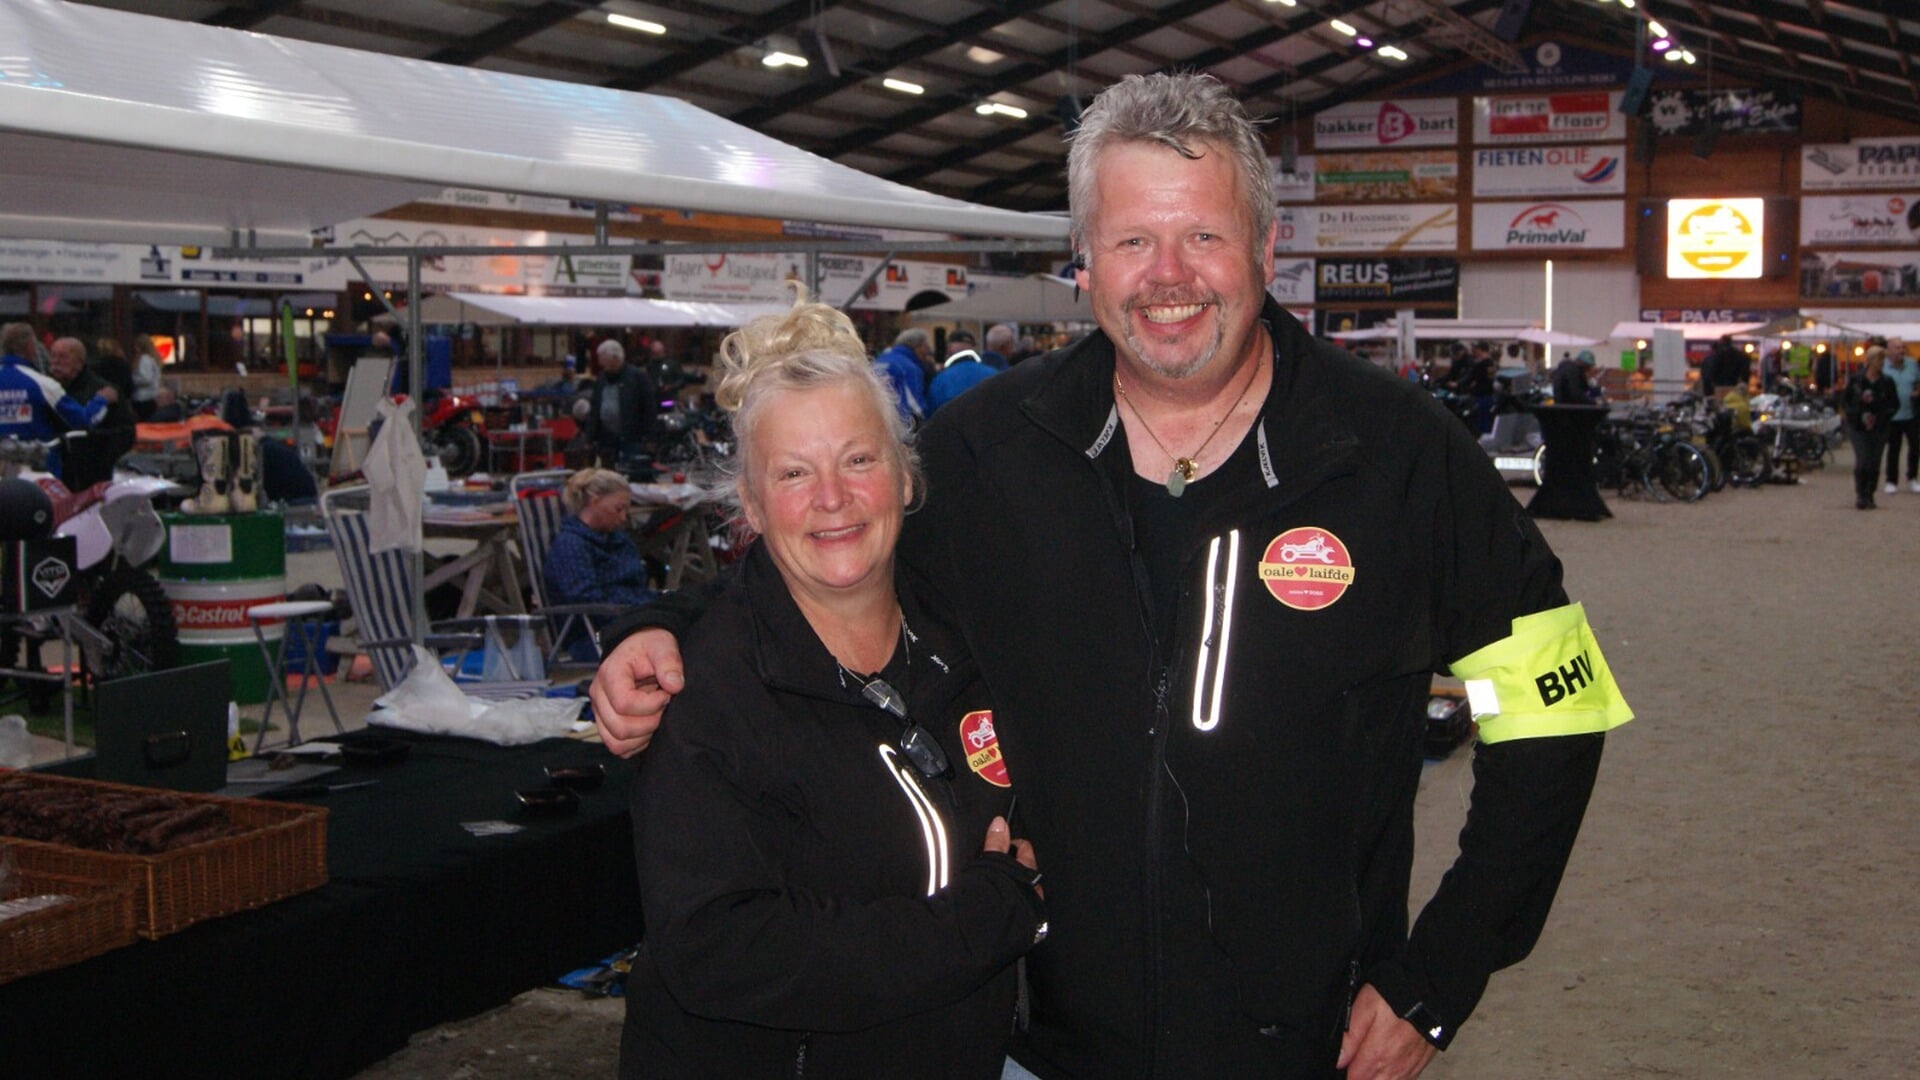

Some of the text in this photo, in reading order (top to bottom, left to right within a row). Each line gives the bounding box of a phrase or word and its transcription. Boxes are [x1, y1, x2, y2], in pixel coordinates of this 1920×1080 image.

[1316, 121, 1375, 134] bakker
[1419, 117, 1456, 130] bart
[1477, 147, 1591, 167] FIETEN OLIE
[1506, 228, 1586, 244] PrimeVal
[1322, 263, 1390, 285] REUS
[1263, 566, 1350, 581] oale laifde
[186, 610, 245, 624] Castrol
[1534, 649, 1595, 708] BHV
[972, 752, 992, 768] oale
